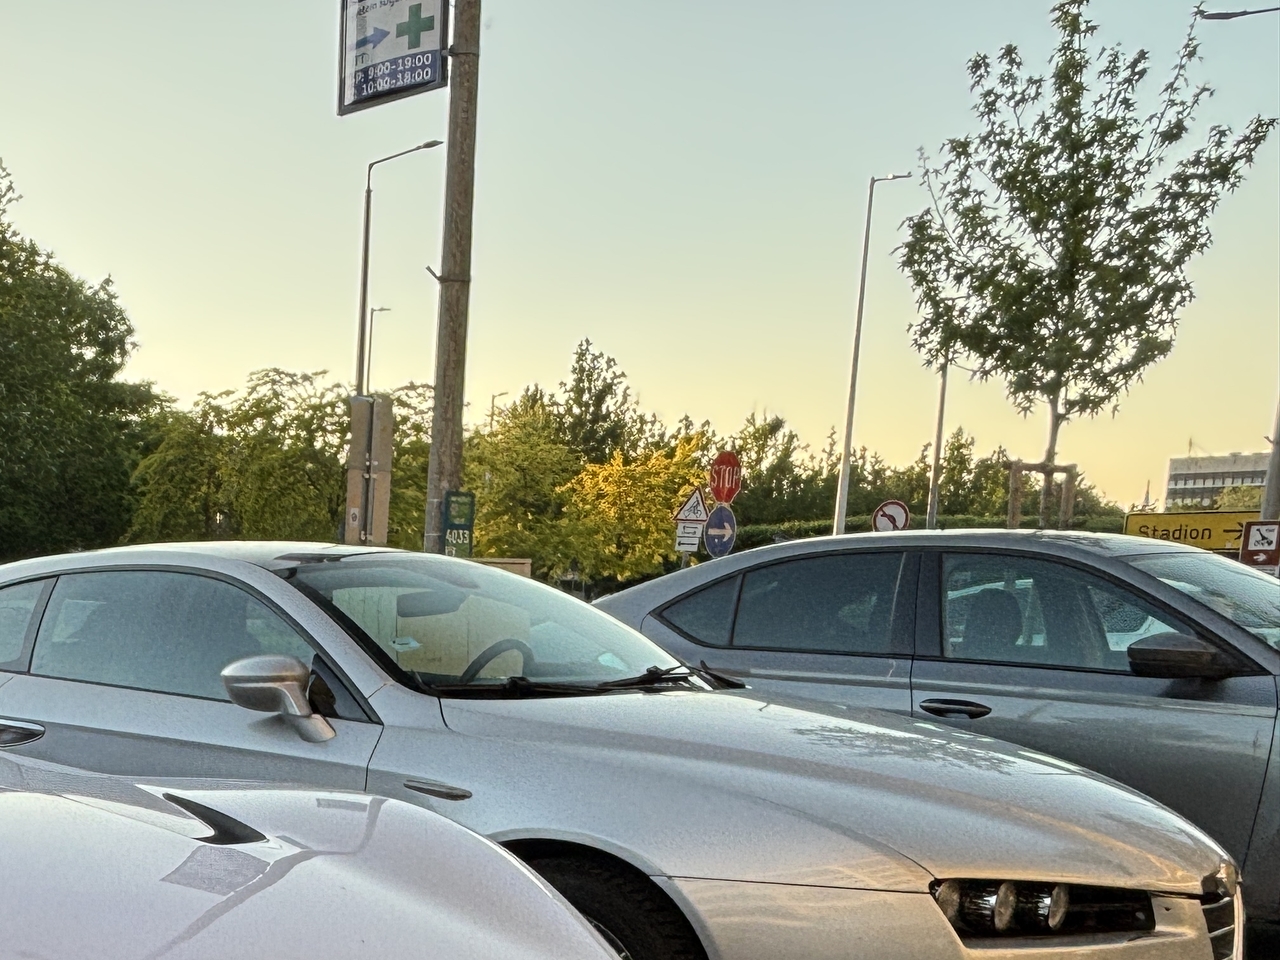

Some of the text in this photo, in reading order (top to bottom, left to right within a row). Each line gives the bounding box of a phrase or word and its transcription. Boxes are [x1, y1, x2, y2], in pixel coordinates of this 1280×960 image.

[368, 53, 432, 79] 9:00-19:00
[711, 465, 740, 489] STOP
[1138, 524, 1212, 540] Stadion
